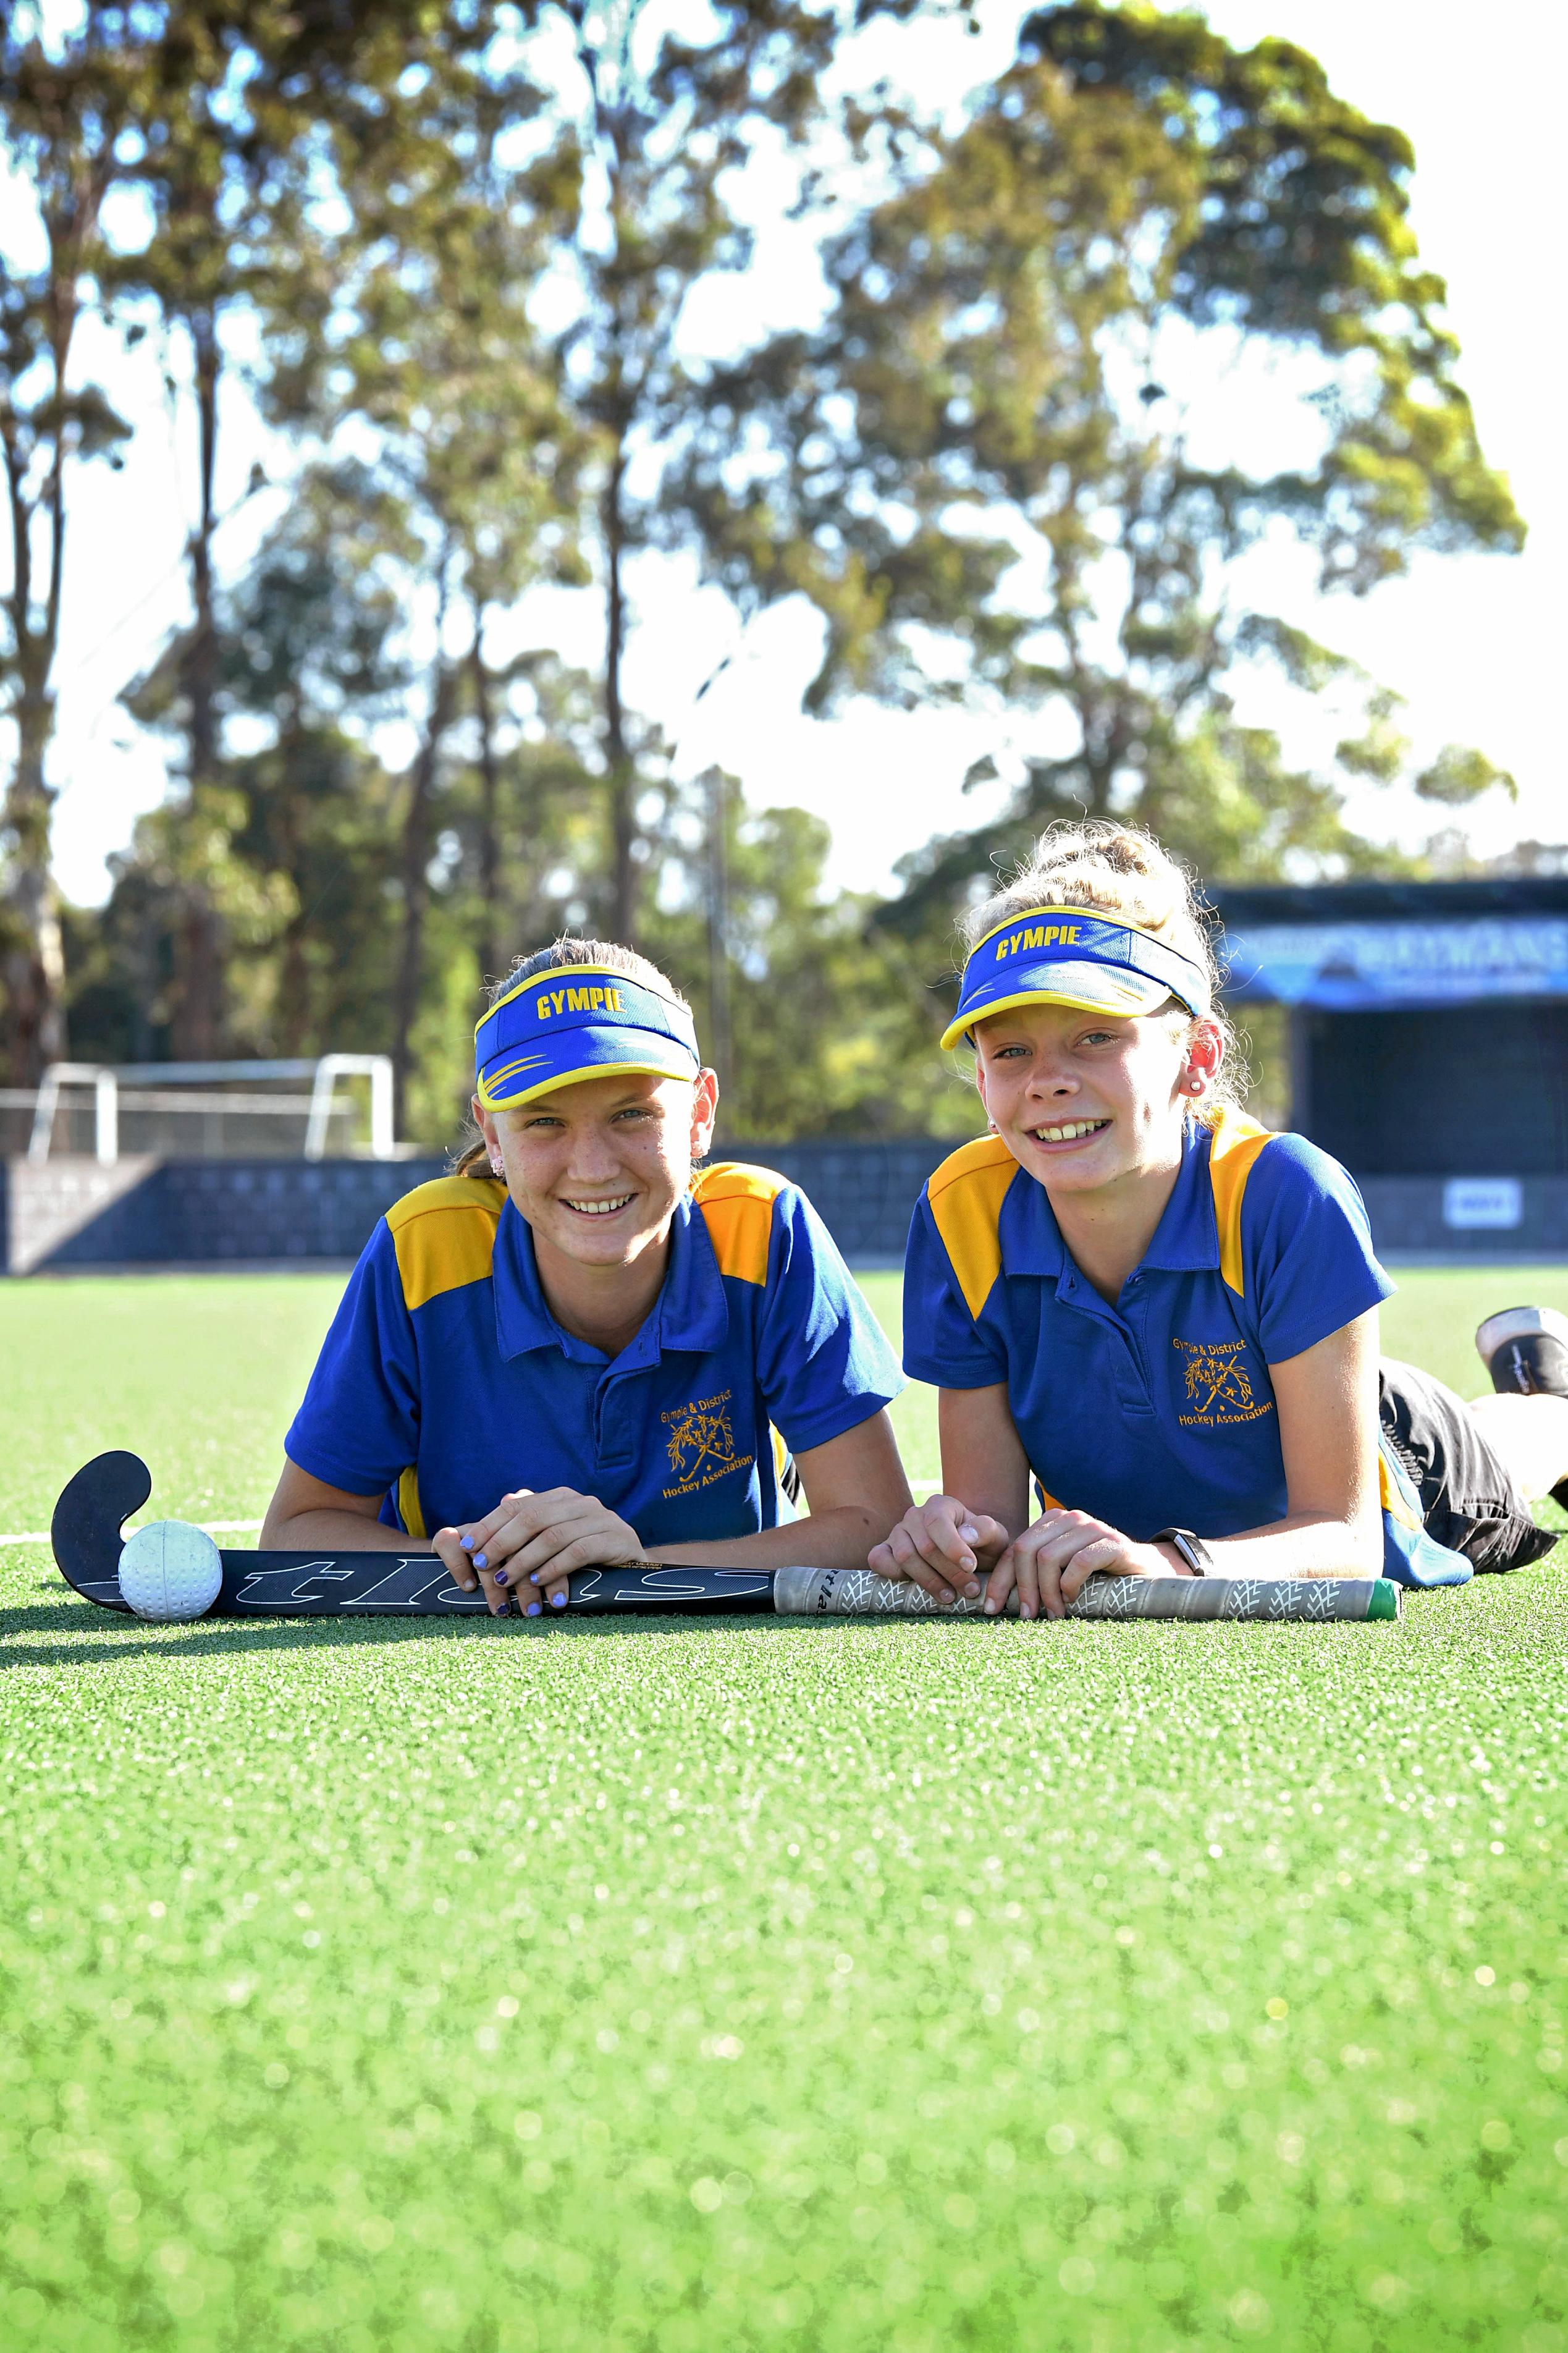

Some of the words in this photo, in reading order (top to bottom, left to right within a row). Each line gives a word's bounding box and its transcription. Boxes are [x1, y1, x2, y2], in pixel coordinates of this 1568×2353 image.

[995, 925, 1082, 962] GYMPIE
[536, 986, 627, 1020] GYMPIE
[1199, 1345, 1207, 1356] &
[1207, 1338, 1247, 1356] District
[688, 1402, 698, 1414] &
[698, 1388, 732, 1411] District
[1178, 1413, 1215, 1427] Hockey
[1216, 1400, 1274, 1424] Association
[662, 1480, 700, 1499] Hockey
[701, 1453, 753, 1487] Association
